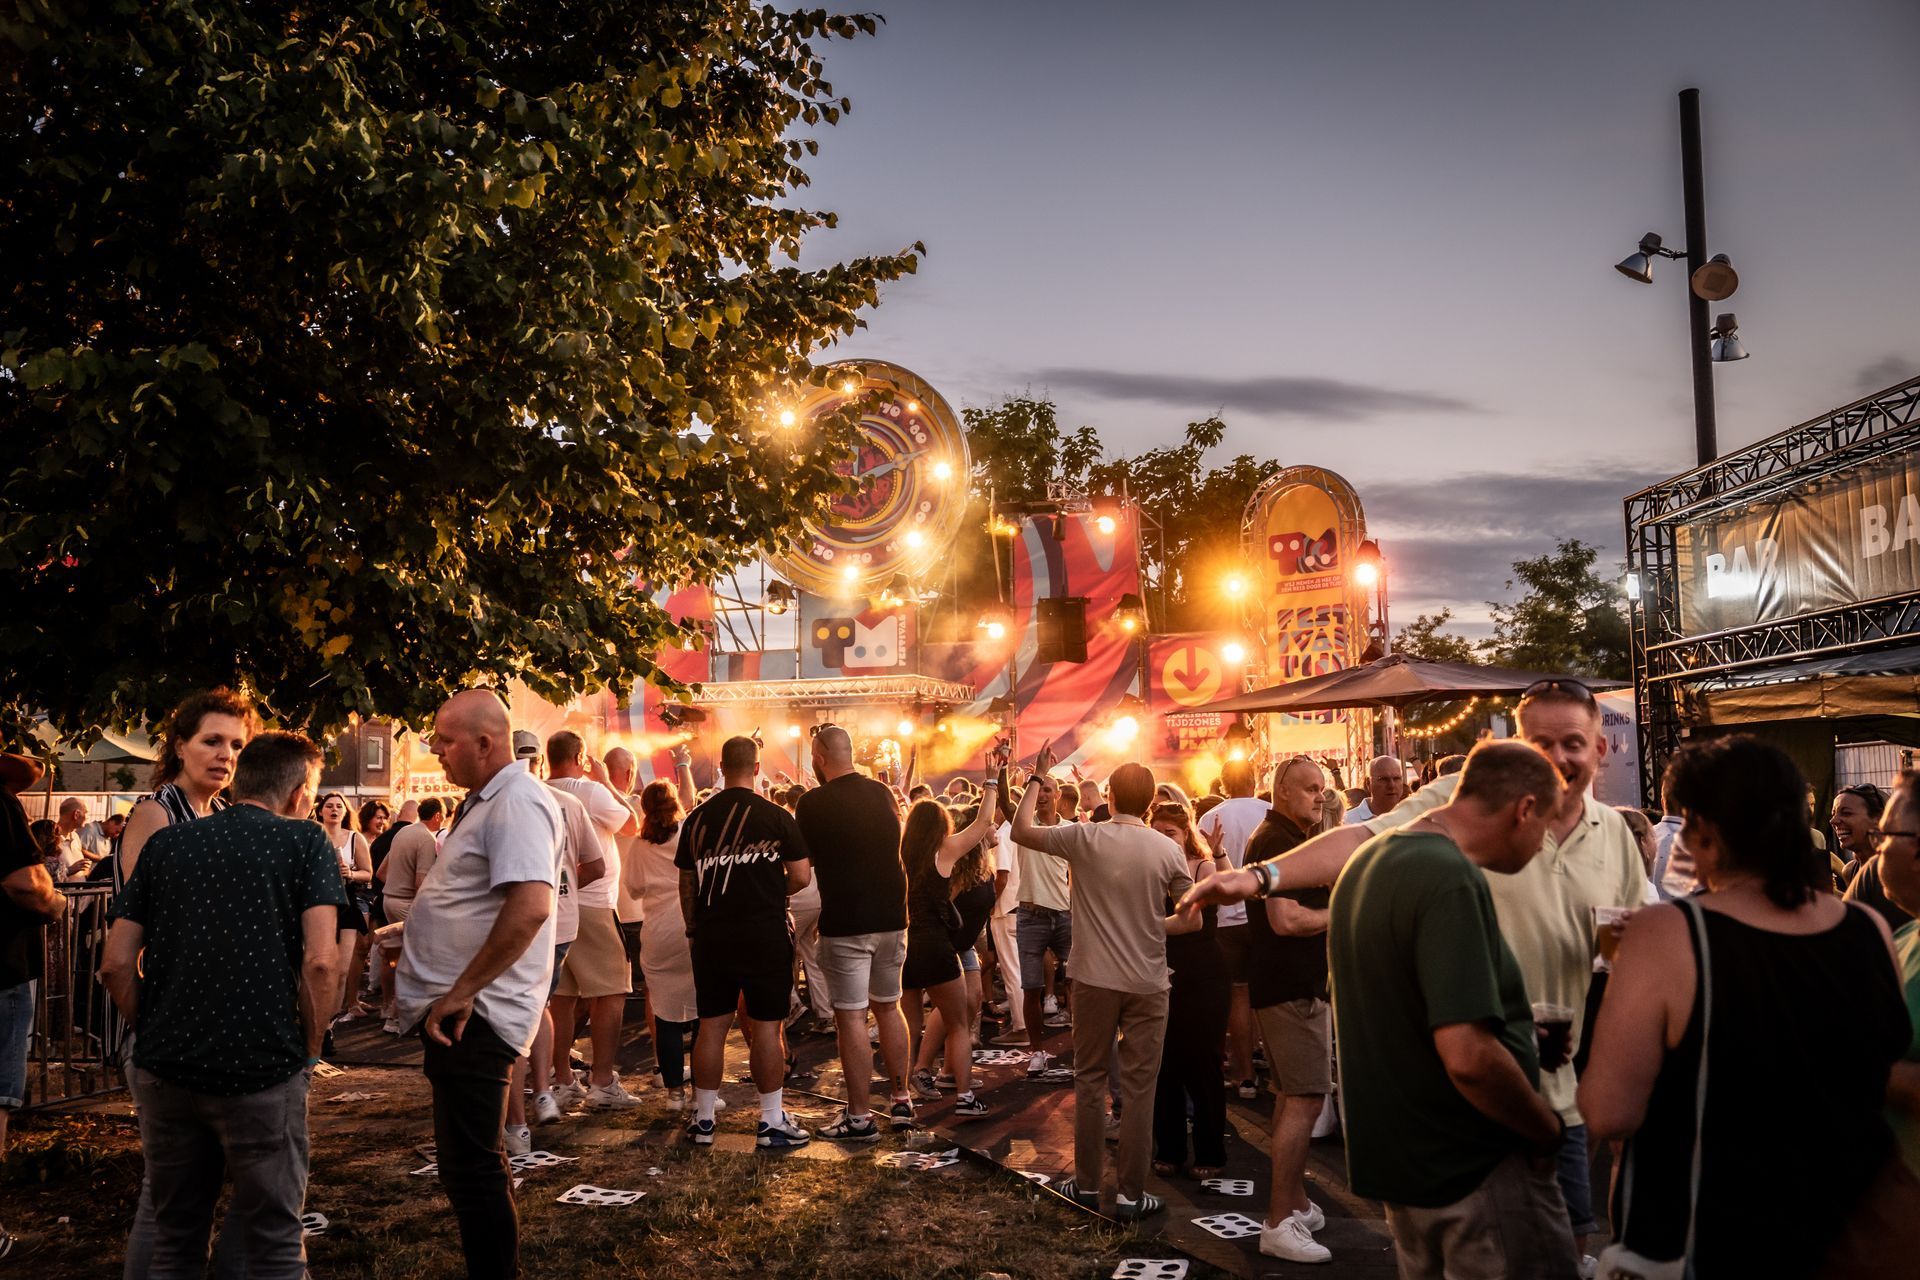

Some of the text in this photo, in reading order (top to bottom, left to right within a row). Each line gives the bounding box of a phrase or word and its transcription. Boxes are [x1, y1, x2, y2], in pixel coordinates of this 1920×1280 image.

[1706, 538, 1780, 599] BAR
[1166, 717, 1222, 727] TIJDZONES
[1601, 712, 1631, 727] RINKS
